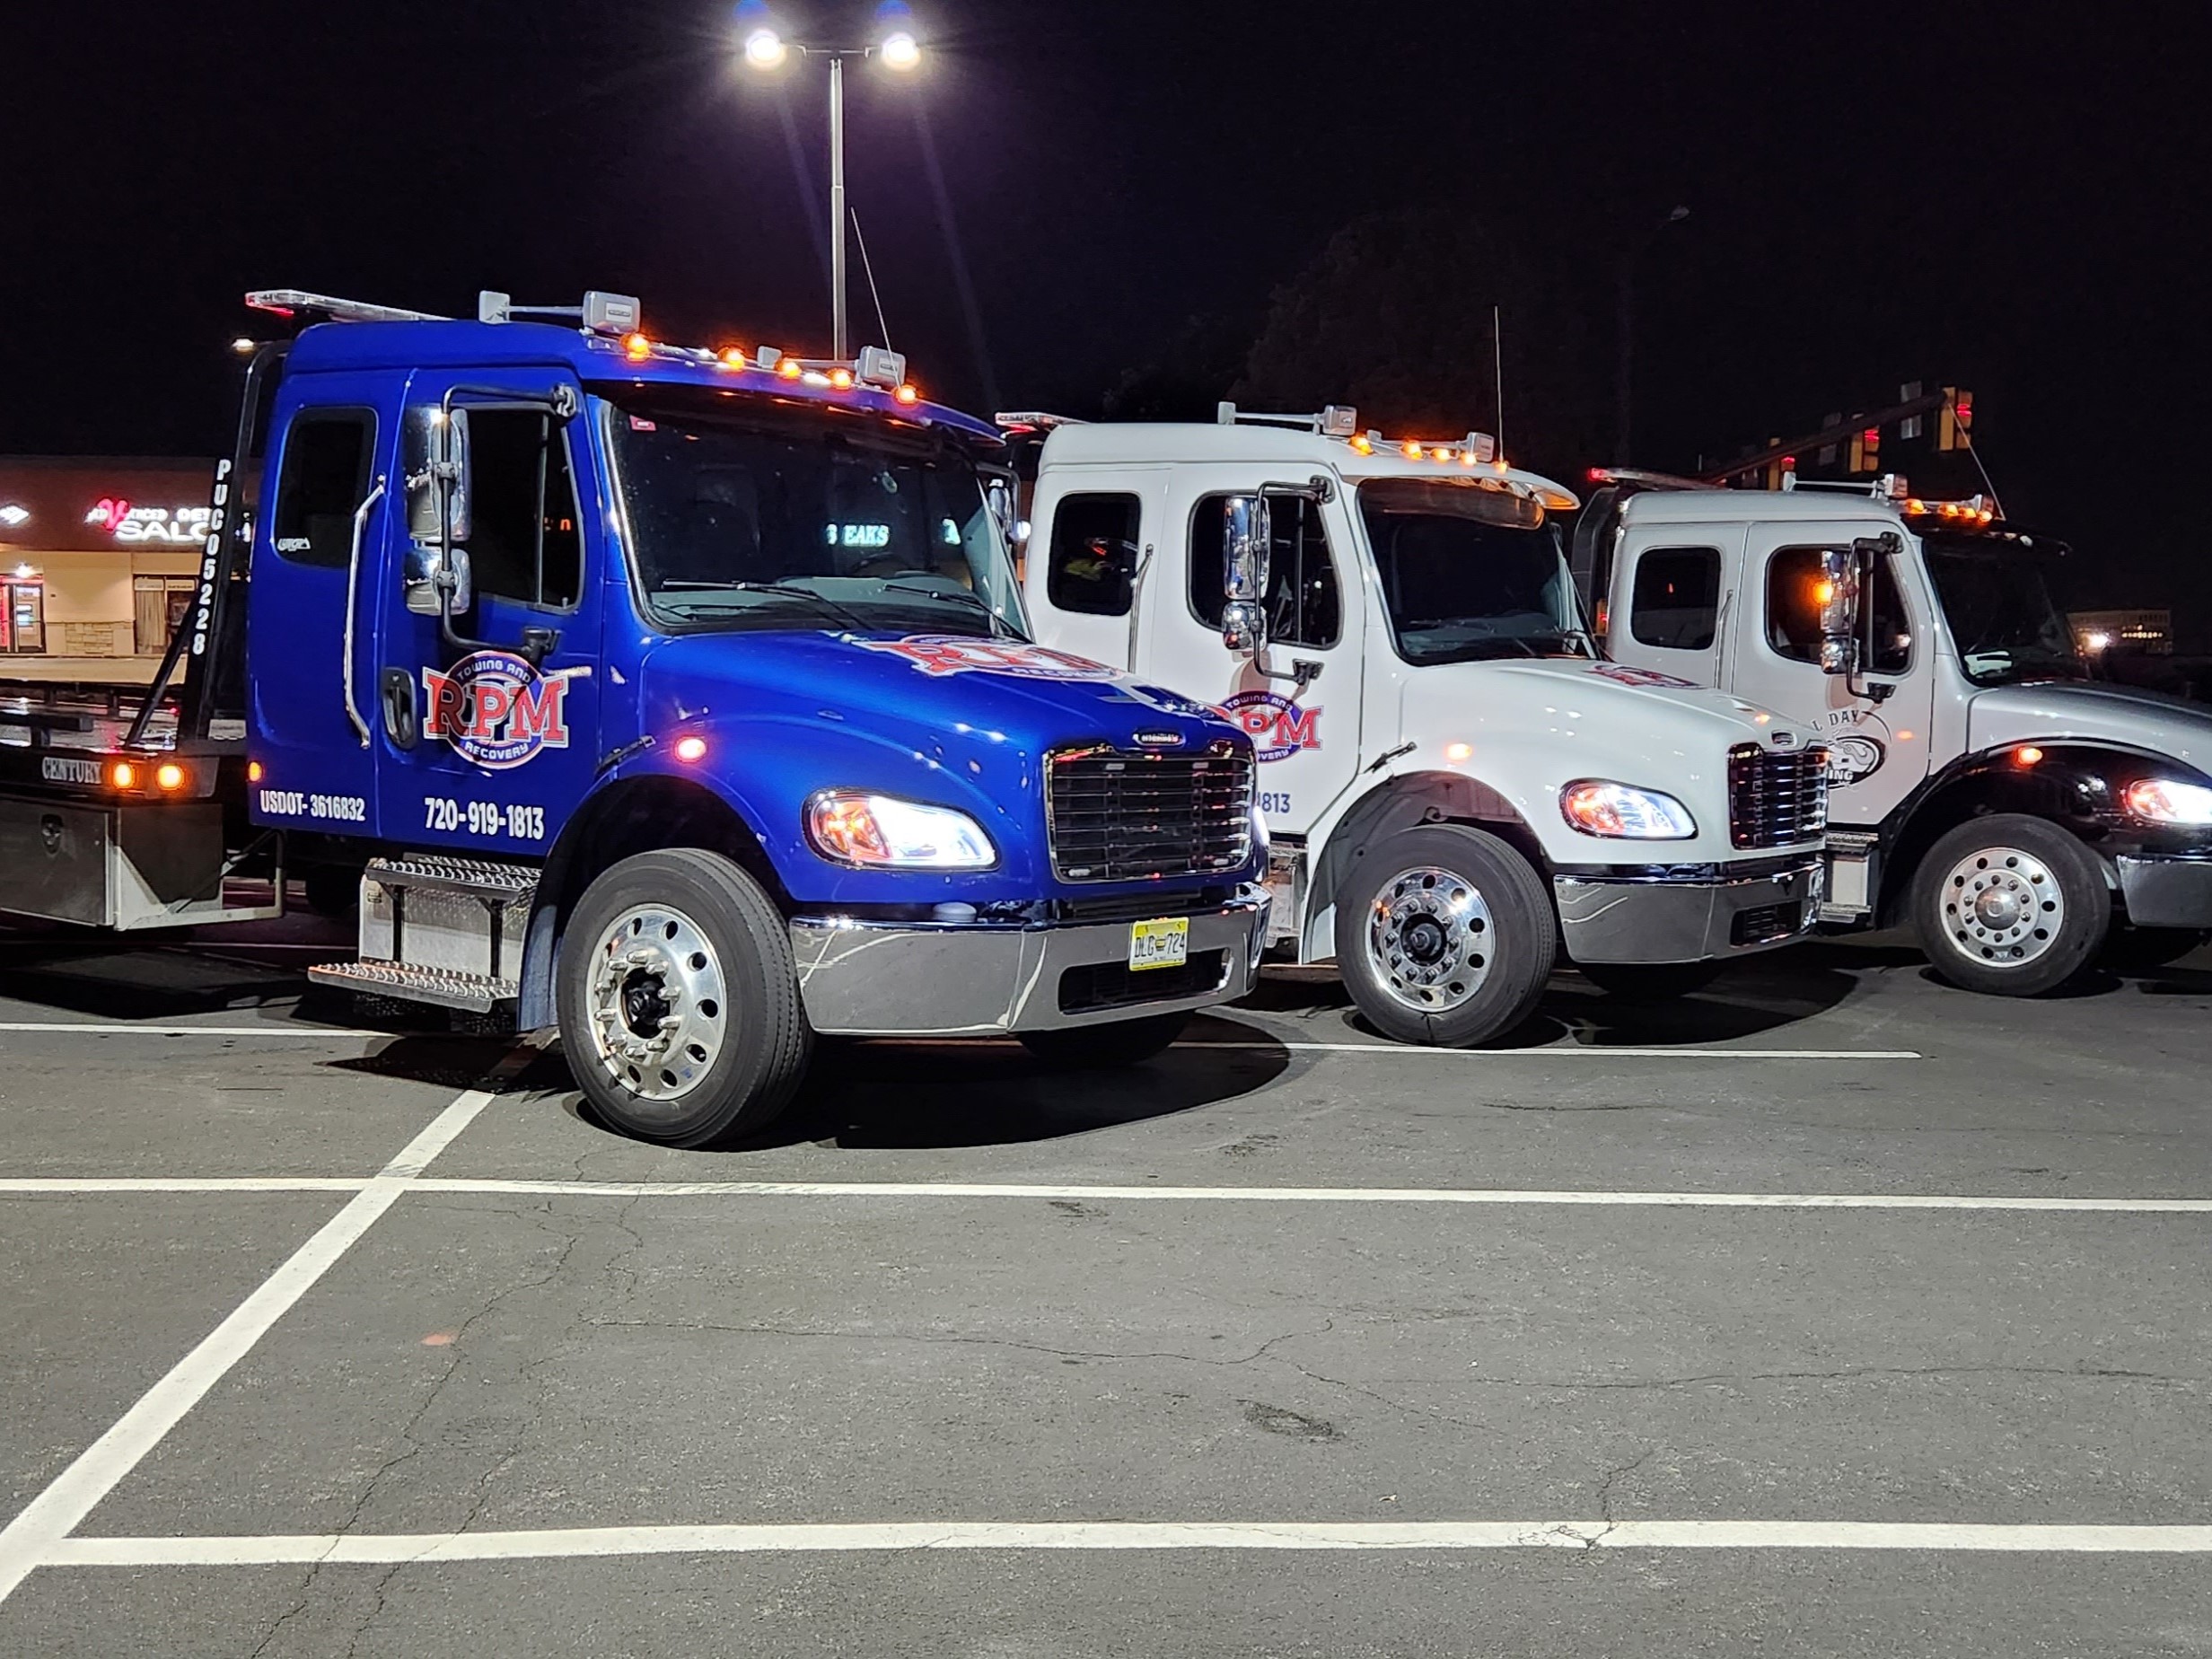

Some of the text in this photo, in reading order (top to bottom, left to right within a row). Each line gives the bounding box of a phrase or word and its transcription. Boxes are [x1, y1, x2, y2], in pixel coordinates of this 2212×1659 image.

[456, 660, 531, 684] TOWING AND
[422, 666, 569, 748] RPM
[1226, 695, 1268, 709] TOWING
[1829, 709, 1859, 726] DAY
[464, 742, 529, 760] RECOVERY
[42, 756, 103, 785] CENTURY
[1828, 768, 1854, 781] ING
[424, 797, 545, 840] 720-919-1813
